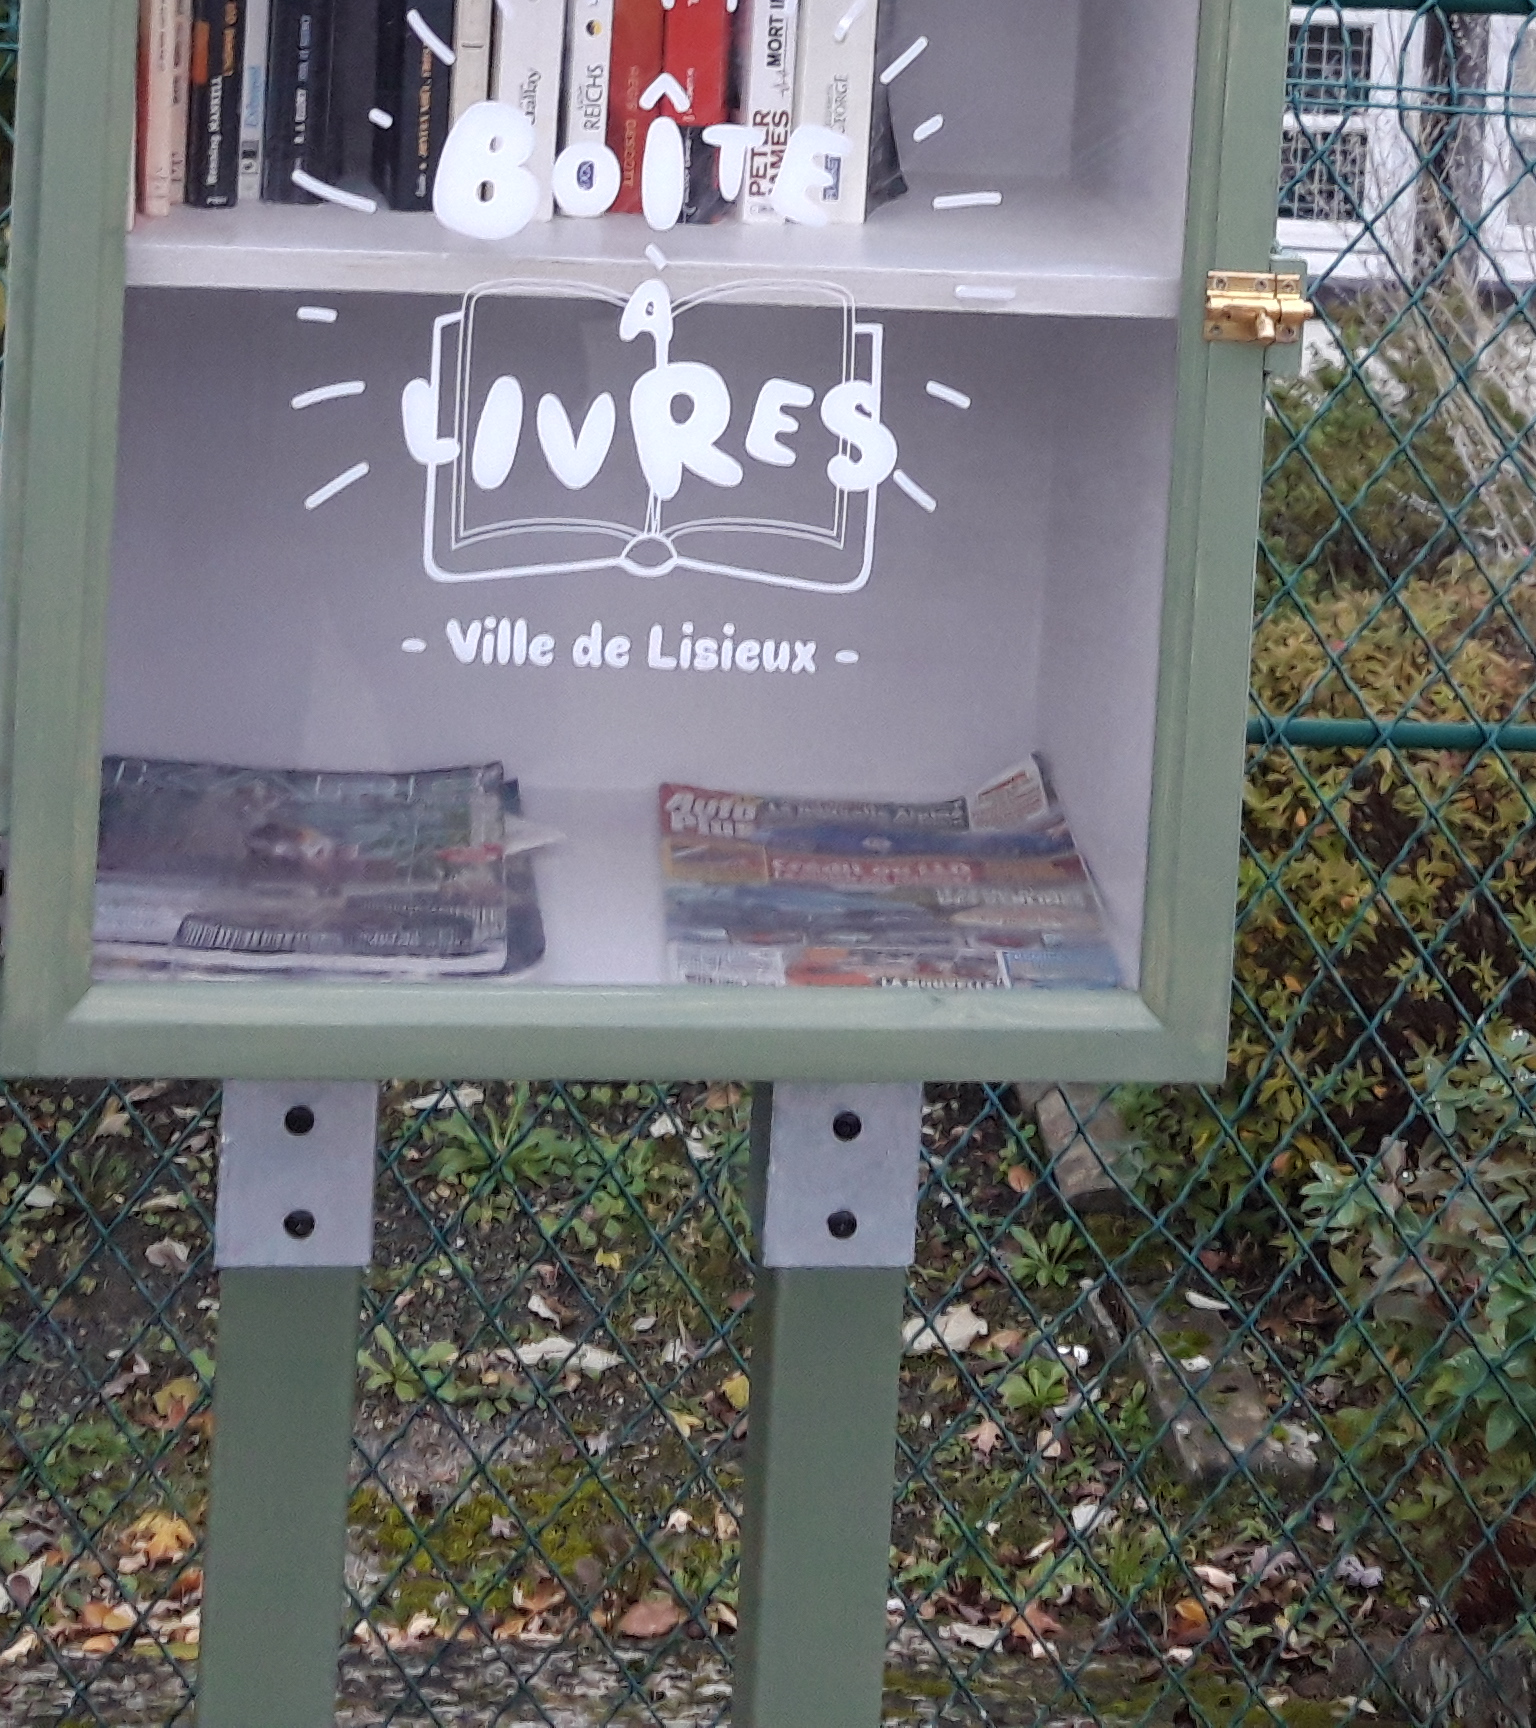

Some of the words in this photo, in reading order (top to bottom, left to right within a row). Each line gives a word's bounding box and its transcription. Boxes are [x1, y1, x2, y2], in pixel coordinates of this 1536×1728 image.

[766, 16, 784, 68] MORT
[584, 64, 604, 130] REICHS
[432, 72, 852, 240] BOÎTE
[402, 362, 898, 501] LIVRES
[446, 616, 556, 666] Ville
[572, 619, 632, 668] de
[647, 621, 818, 674] Lisieux
